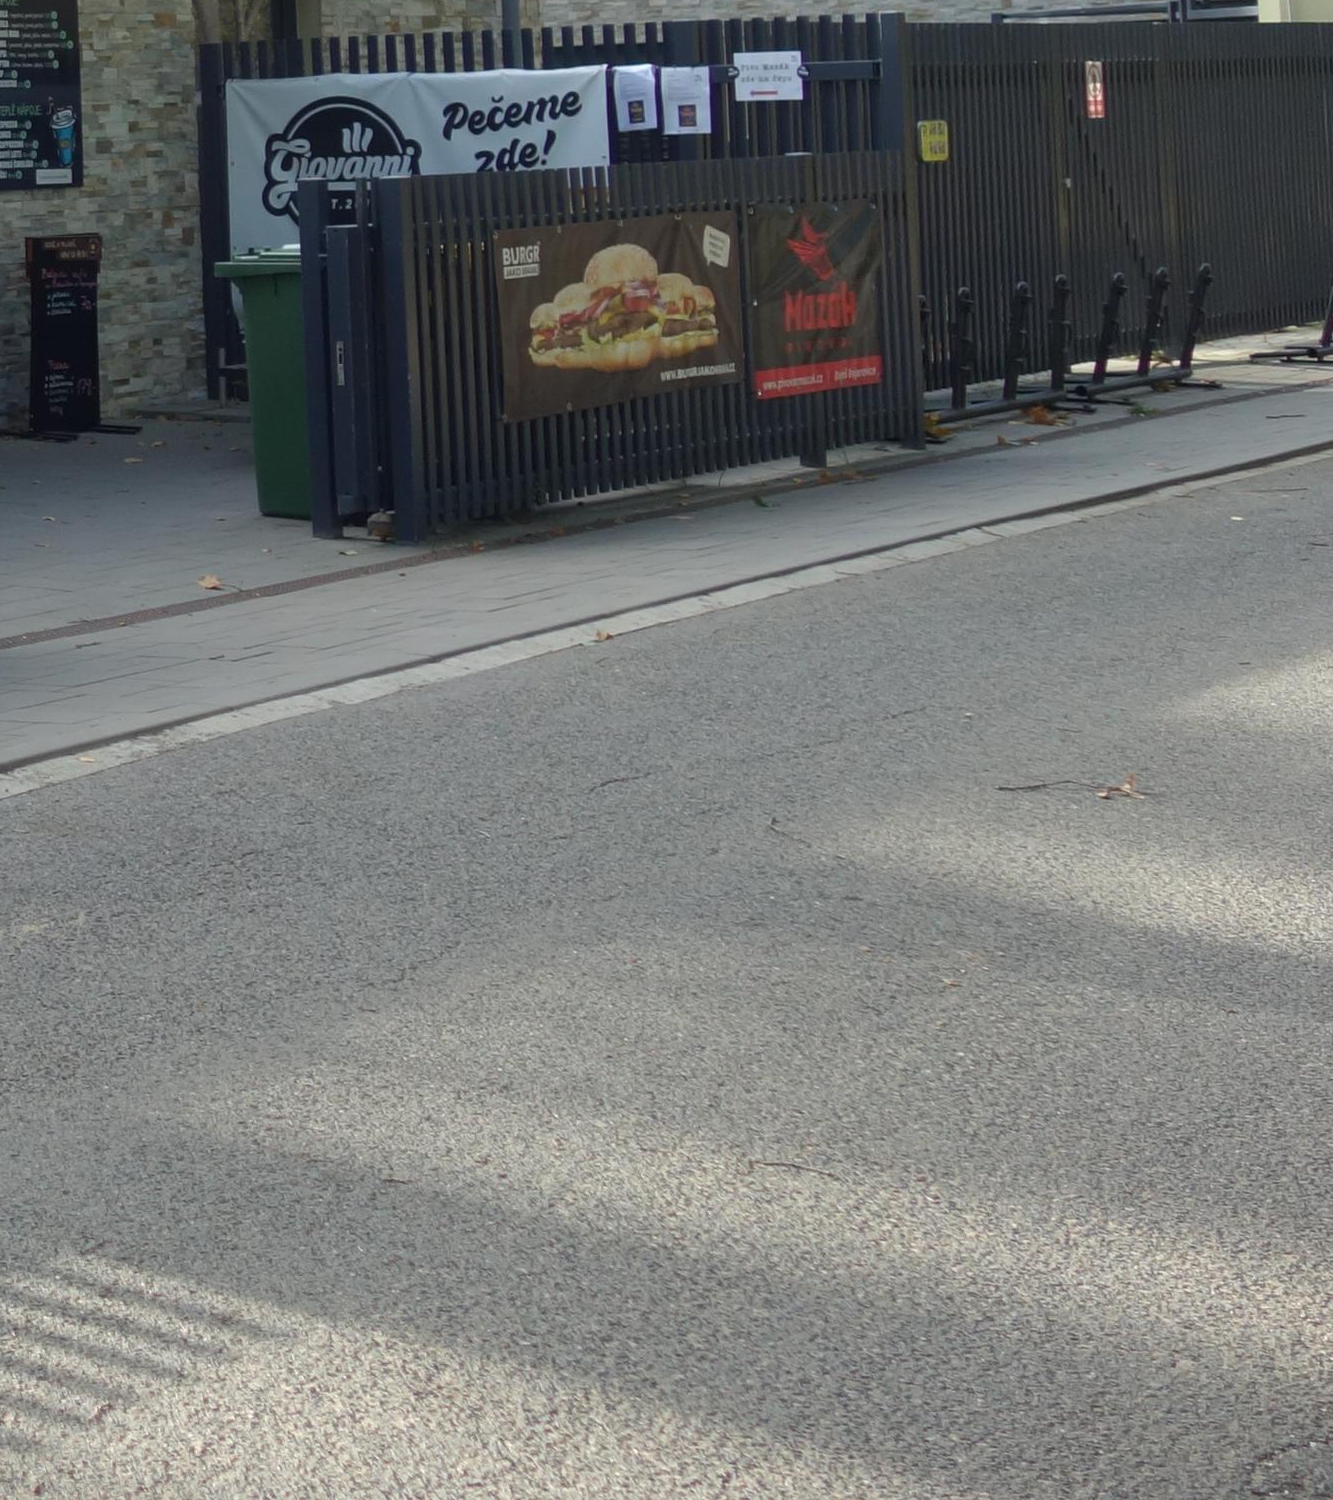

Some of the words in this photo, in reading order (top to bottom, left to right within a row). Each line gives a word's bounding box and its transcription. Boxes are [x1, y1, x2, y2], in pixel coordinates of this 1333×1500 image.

[442, 90, 584, 141] Pečeme
[269, 138, 415, 209] Giovanni
[474, 130, 557, 173] zde!
[502, 245, 541, 266] BURGR
